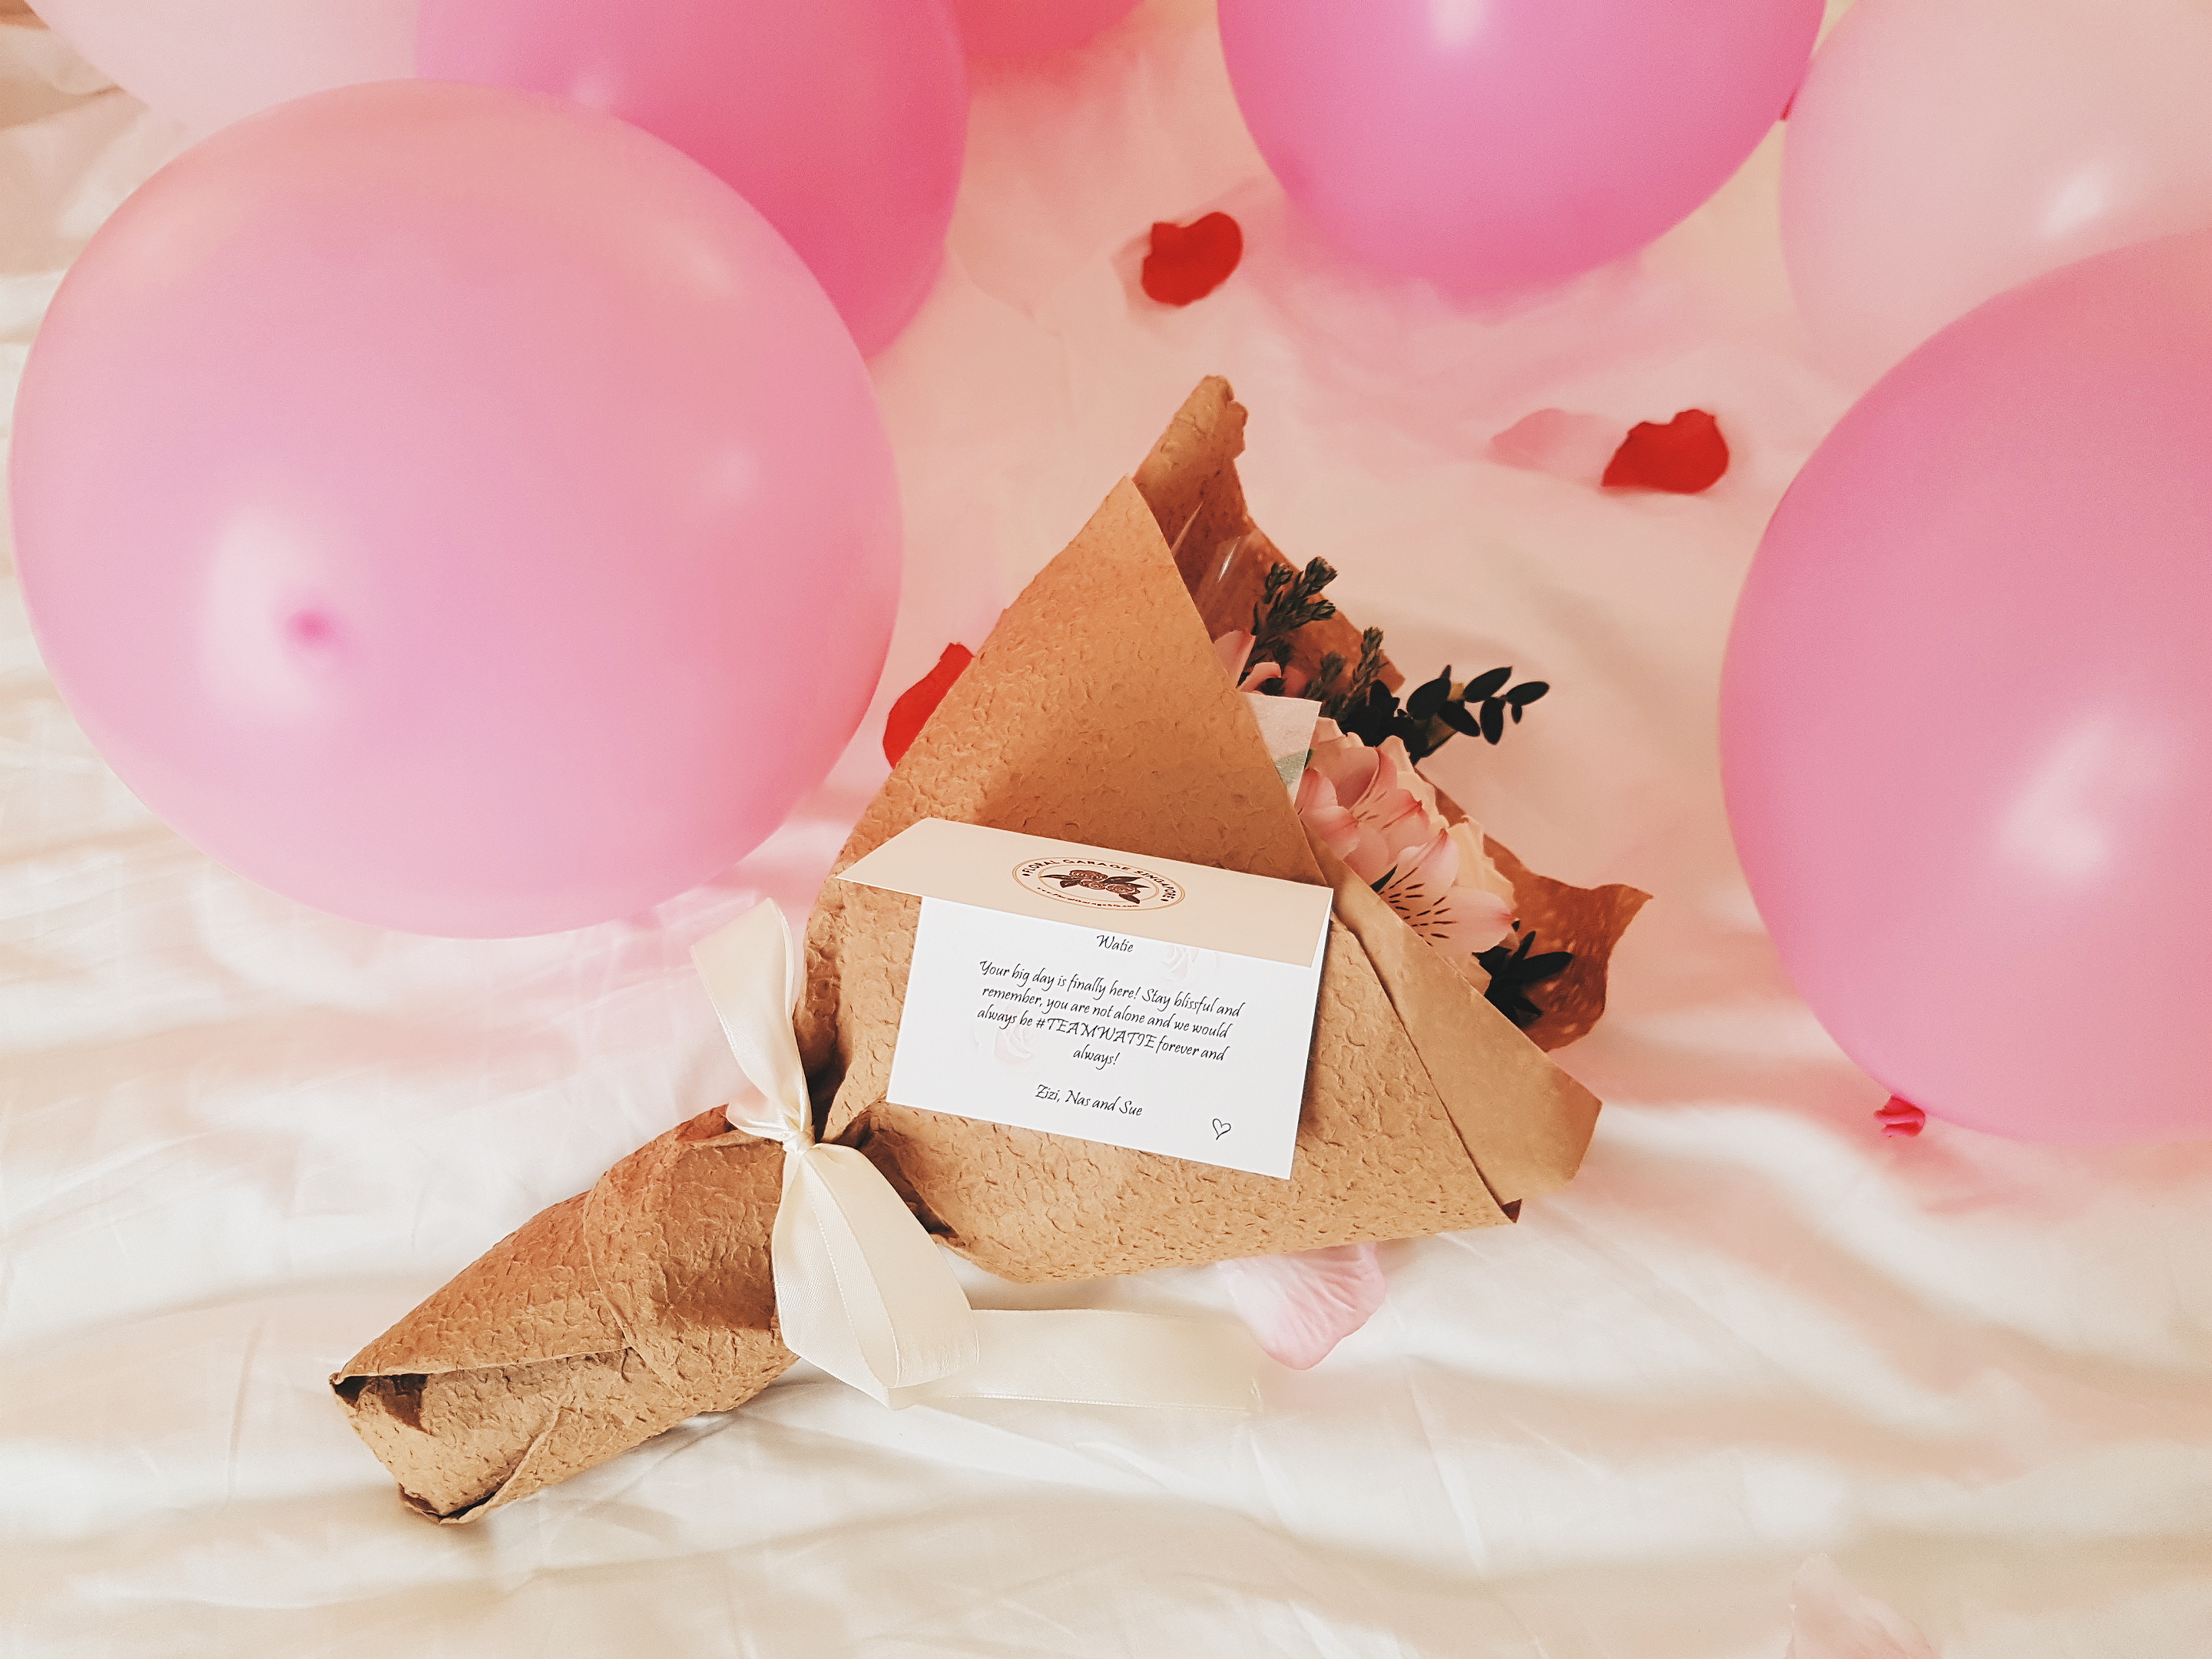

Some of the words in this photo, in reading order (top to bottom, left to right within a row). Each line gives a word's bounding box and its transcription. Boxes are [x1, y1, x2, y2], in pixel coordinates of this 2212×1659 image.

[1022, 860, 1060, 874] FLORAL
[1063, 859, 1131, 871] GARAGE
[1097, 935, 1134, 952] Watie
[980, 961, 1010, 975] Your
[1012, 964, 1030, 987] big
[1032, 968, 1055, 992] day
[1057, 976, 1067, 987] is
[1068, 974, 1107, 1000] finally
[1110, 980, 1141, 998] here!
[1142, 988, 1171, 1012] Stay
[1174, 992, 1219, 1014] blissful
[1217, 1002, 1246, 1017] and
[982, 988, 1043, 1006] remember,
[1041, 999, 1068, 1014] you
[1071, 1003, 1090, 1014] are
[1093, 1005, 1114, 1017] not
[1114, 1005, 1145, 1024] alone
[1147, 1014, 1177, 1028] and
[1174, 1022, 1190, 1031] we
[1193, 1022, 1233, 1038] would
[978, 1004, 1018, 1029] always
[1020, 1011, 1033, 1027] be
[1036, 1018, 1157, 1048] #TEAMWATIE
[1156, 1035, 1200, 1056] forever
[1201, 1046, 1230, 1061] and
[1074, 1045, 1121, 1070] always!
[1035, 1084, 1061, 1104] Zizi,
[1065, 1090, 1089, 1107] Nas
[1092, 1097, 1121, 1111] and
[1119, 1101, 1143, 1116] Sue
